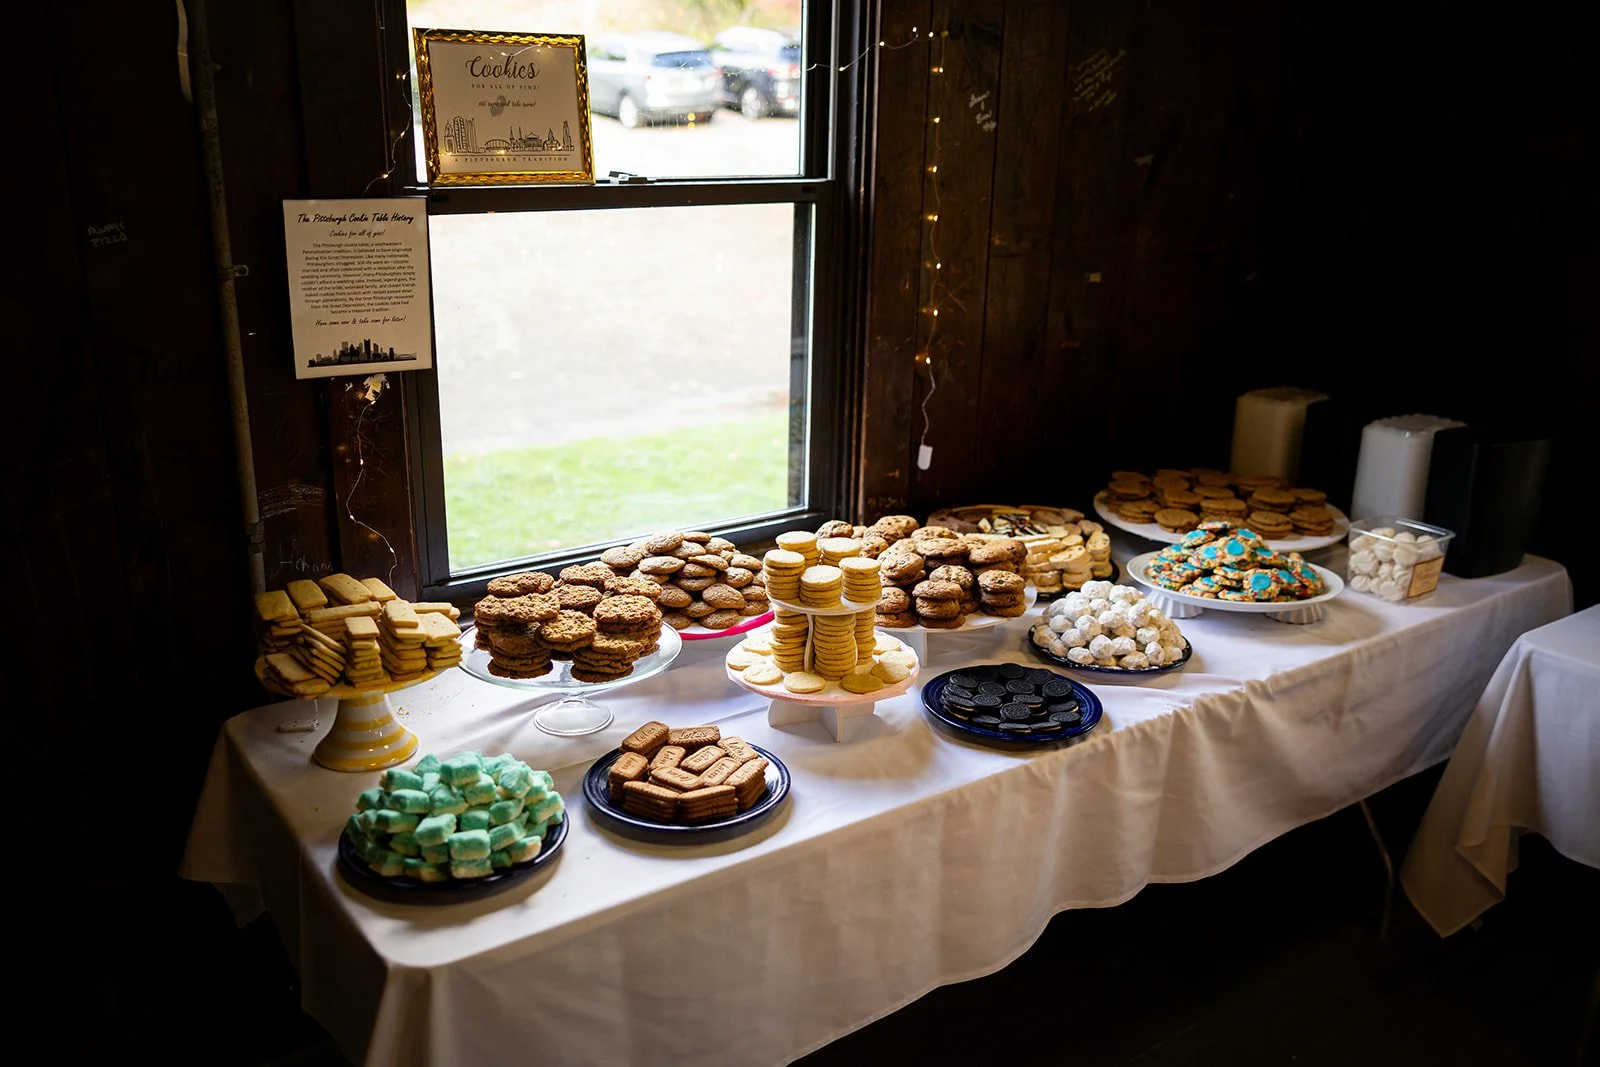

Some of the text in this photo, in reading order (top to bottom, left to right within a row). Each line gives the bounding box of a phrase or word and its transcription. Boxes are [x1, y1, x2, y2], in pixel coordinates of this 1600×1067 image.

[465, 53, 540, 79] Cookies
[298, 212, 414, 225] The Pittsburgh Cookie Table History
[348, 230, 357, 238] for
[367, 229, 373, 238] of
[382, 316, 390, 324] for
[634, 727, 655, 742] Lotus
[678, 731, 707, 740] Lotus
